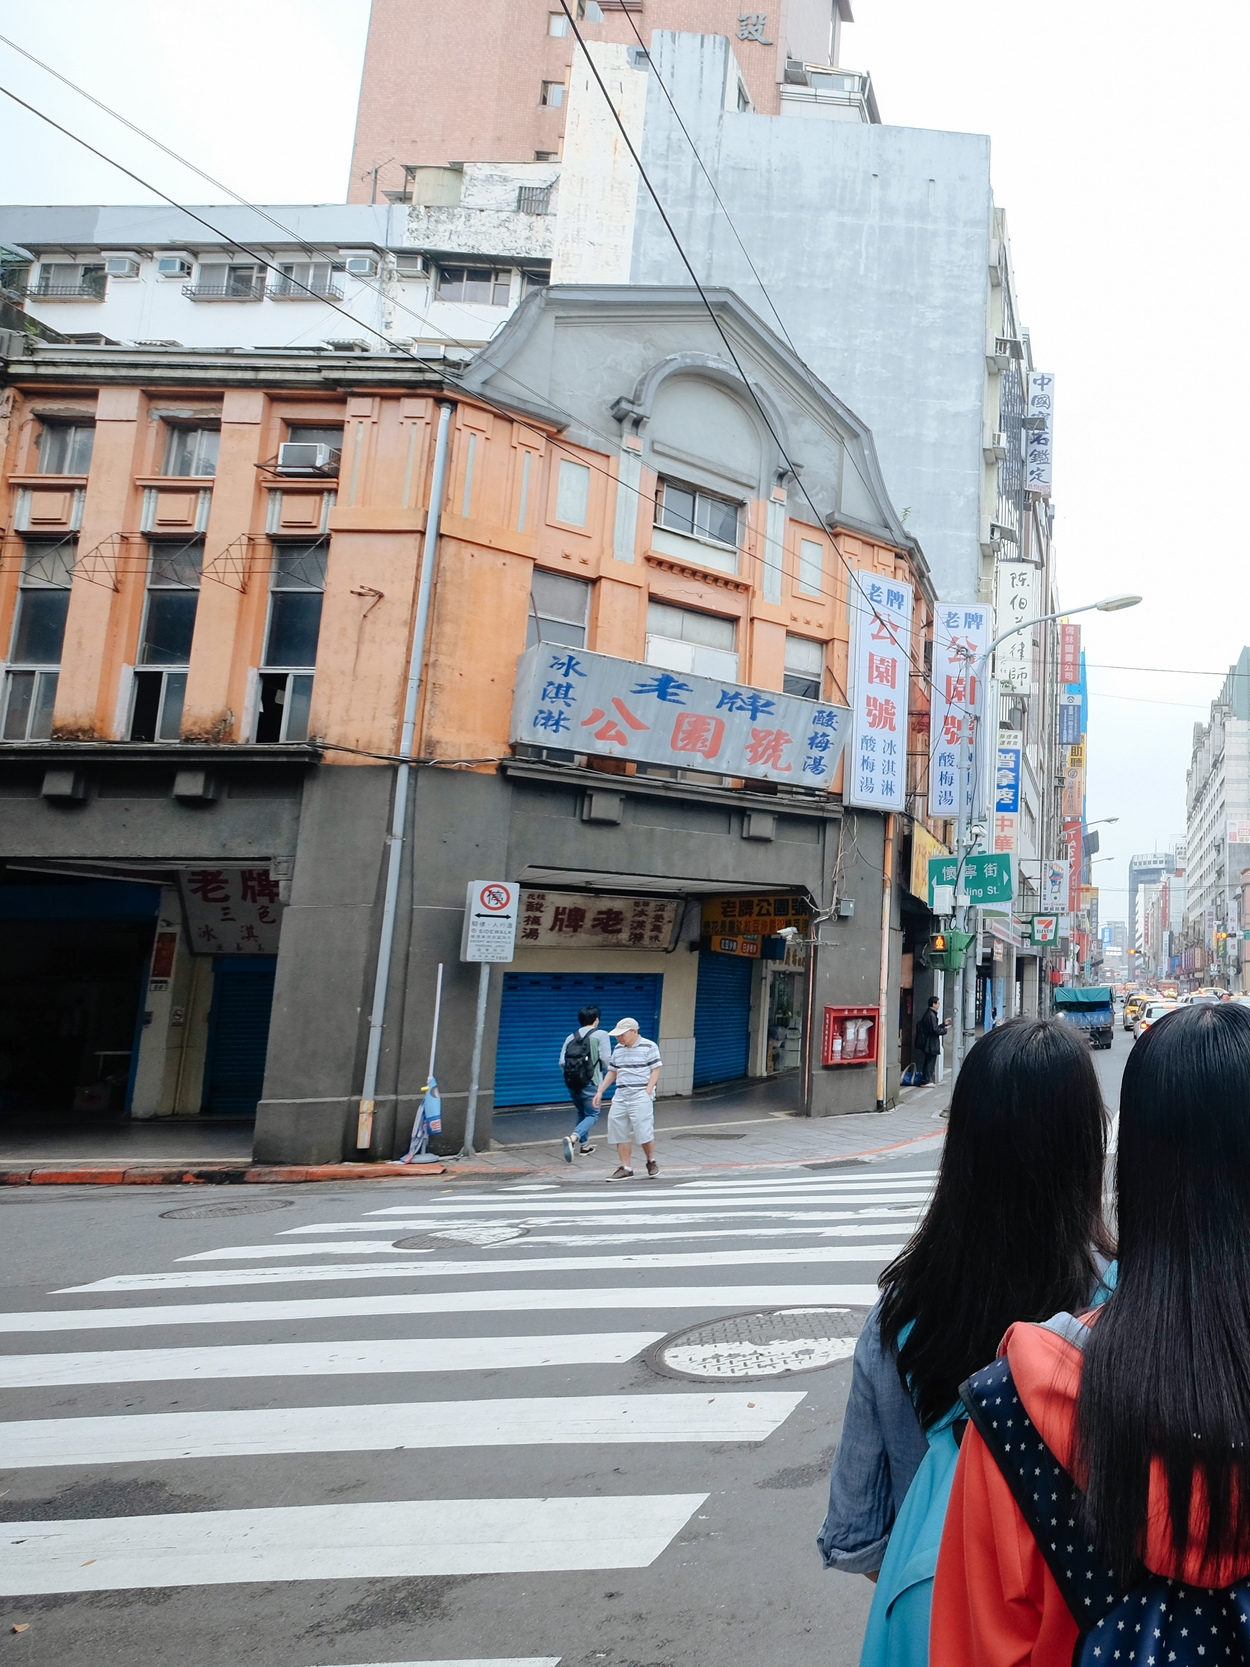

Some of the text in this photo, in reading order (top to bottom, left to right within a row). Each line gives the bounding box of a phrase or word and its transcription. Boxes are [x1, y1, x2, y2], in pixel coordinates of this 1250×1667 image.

[736, 13, 773, 45] 設
[866, 582, 905, 611] 老牌
[943, 611, 983, 631] 老牌
[533, 654, 587, 734] 冰淇淋
[630, 673, 776, 721] 老牌
[865, 612, 901, 732] 公園號
[580, 697, 795, 772] 公園號
[802, 709, 839, 777] 酸梅湯
[860, 734, 876, 794] 酸梅湯
[880, 737, 897, 796] 冰淇淋
[938, 752, 955, 806] 酸梅湯
[942, 863, 998, 882] 懷寧街
[987, 886, 999, 895] St.
[521, 901, 545, 941] 酸梅湯
